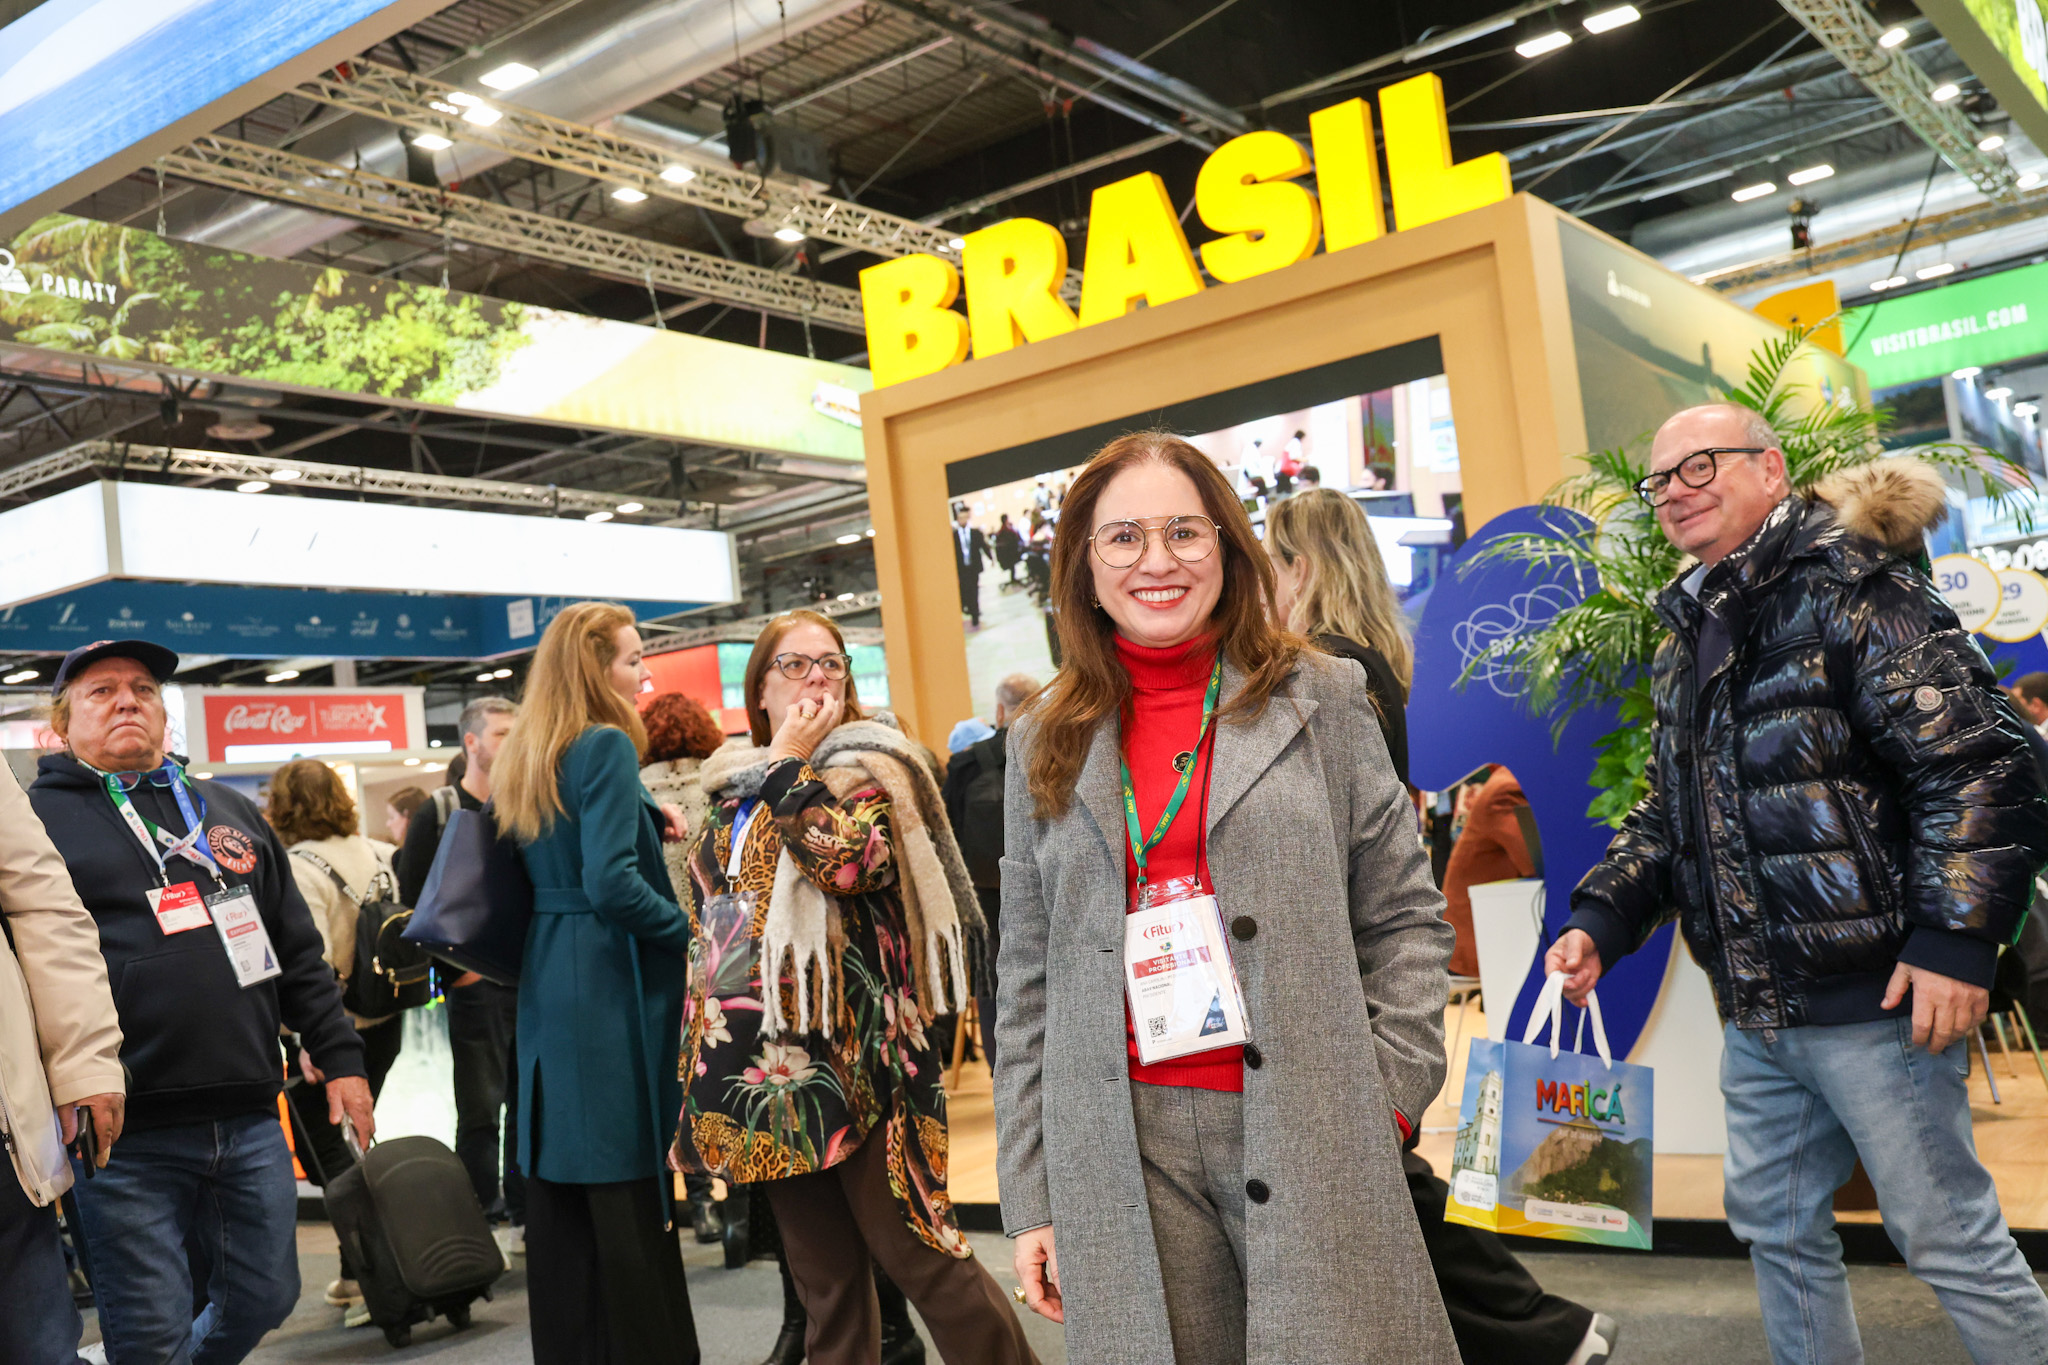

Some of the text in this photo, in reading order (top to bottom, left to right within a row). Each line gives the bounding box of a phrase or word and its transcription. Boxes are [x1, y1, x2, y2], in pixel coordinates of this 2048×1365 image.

[858, 72, 1513, 391] BRASIL
[42, 273, 117, 305] PARATY
[1870, 303, 2029, 357] VISITBRASIL.COM
[1940, 571, 1968, 592] 30
[1159, 812, 1171, 830] ABAV
[1149, 923, 1178, 939] Fitur
[1148, 958, 1195, 973] PROFESIONAL
[1152, 953, 1188, 966] VISITANTE
